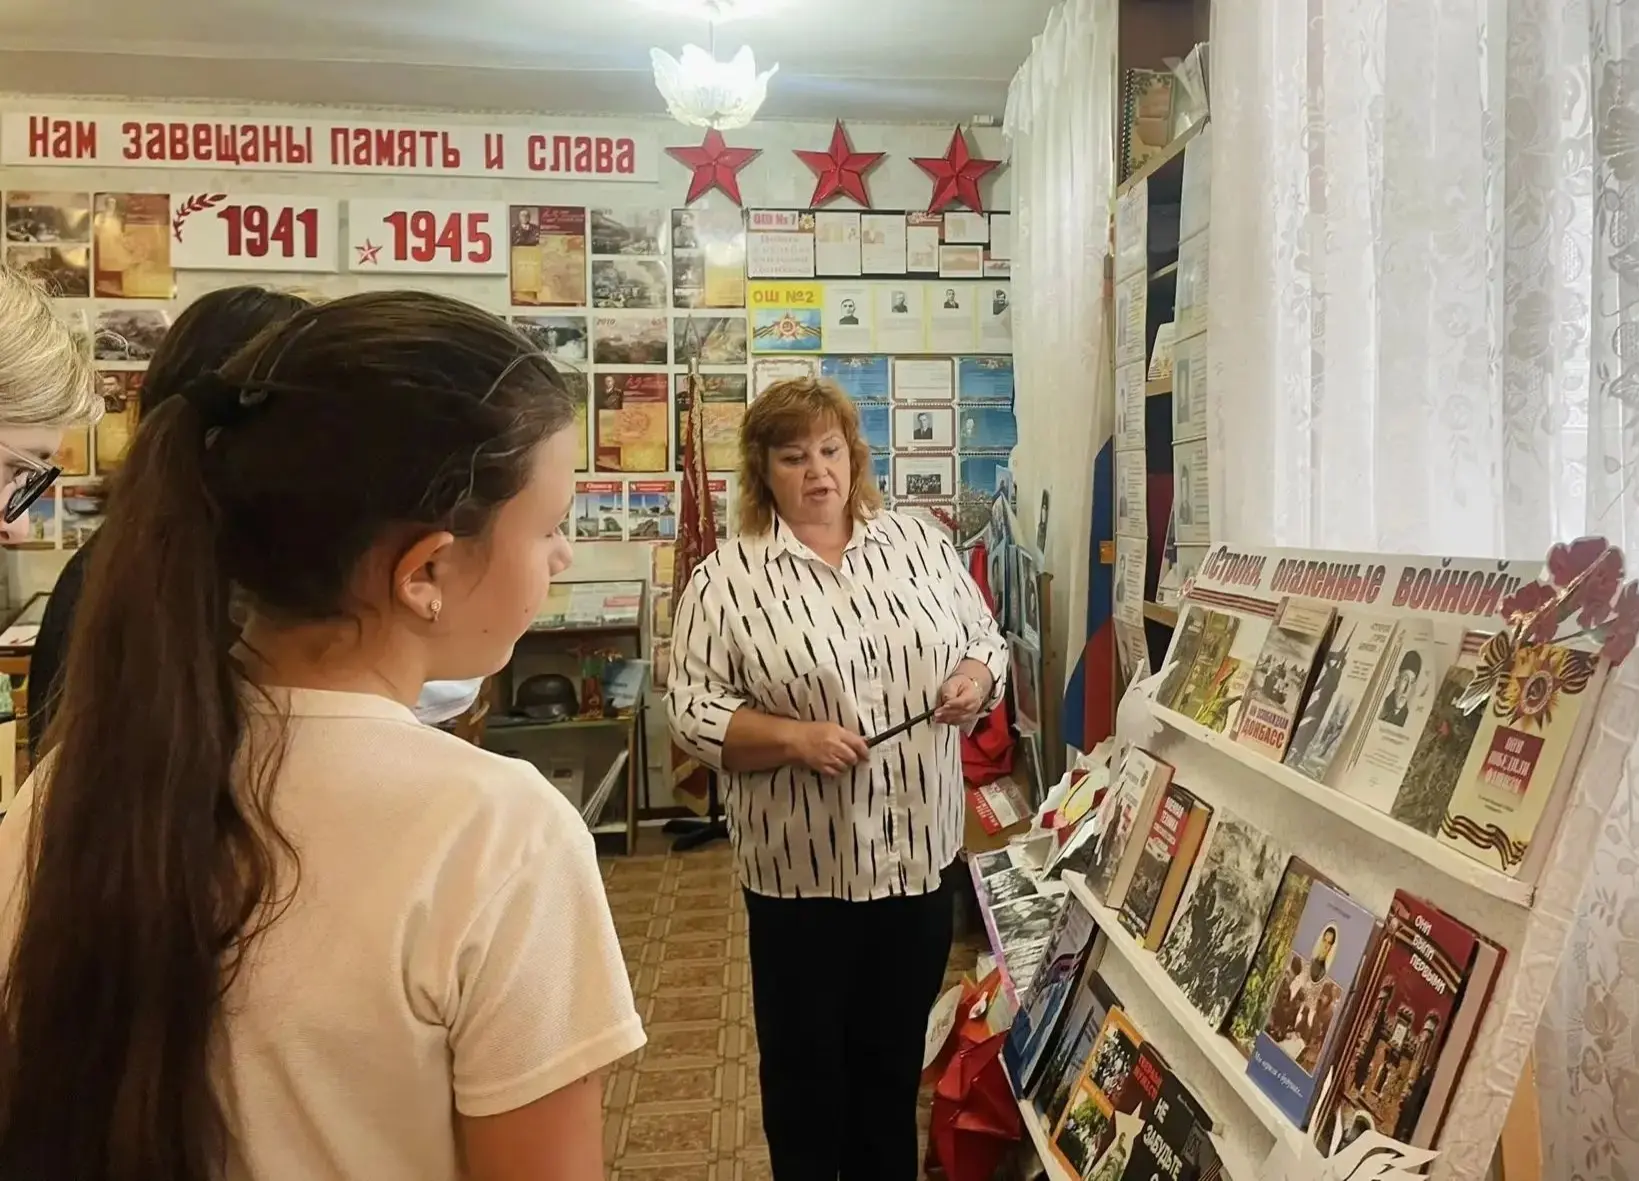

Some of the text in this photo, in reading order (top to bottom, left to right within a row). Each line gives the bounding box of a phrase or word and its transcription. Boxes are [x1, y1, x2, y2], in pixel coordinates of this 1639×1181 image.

[29, 116, 636, 174] Нам завещаны память и слава
[217, 205, 318, 258] 1941
[383, 210, 492, 263] 1945
[752, 290, 815, 303] ОШ №2
[1269, 558, 1386, 604] опаленные
[1414, 914, 1432, 936] ОНИ
[1412, 934, 1435, 961] БЫЛИ
[1409, 953, 1446, 995] ПЕРВЫМИ
[1153, 1097, 1170, 1124] НЕ
[1142, 1124, 1183, 1181] ЗАБУДЬТЕ
